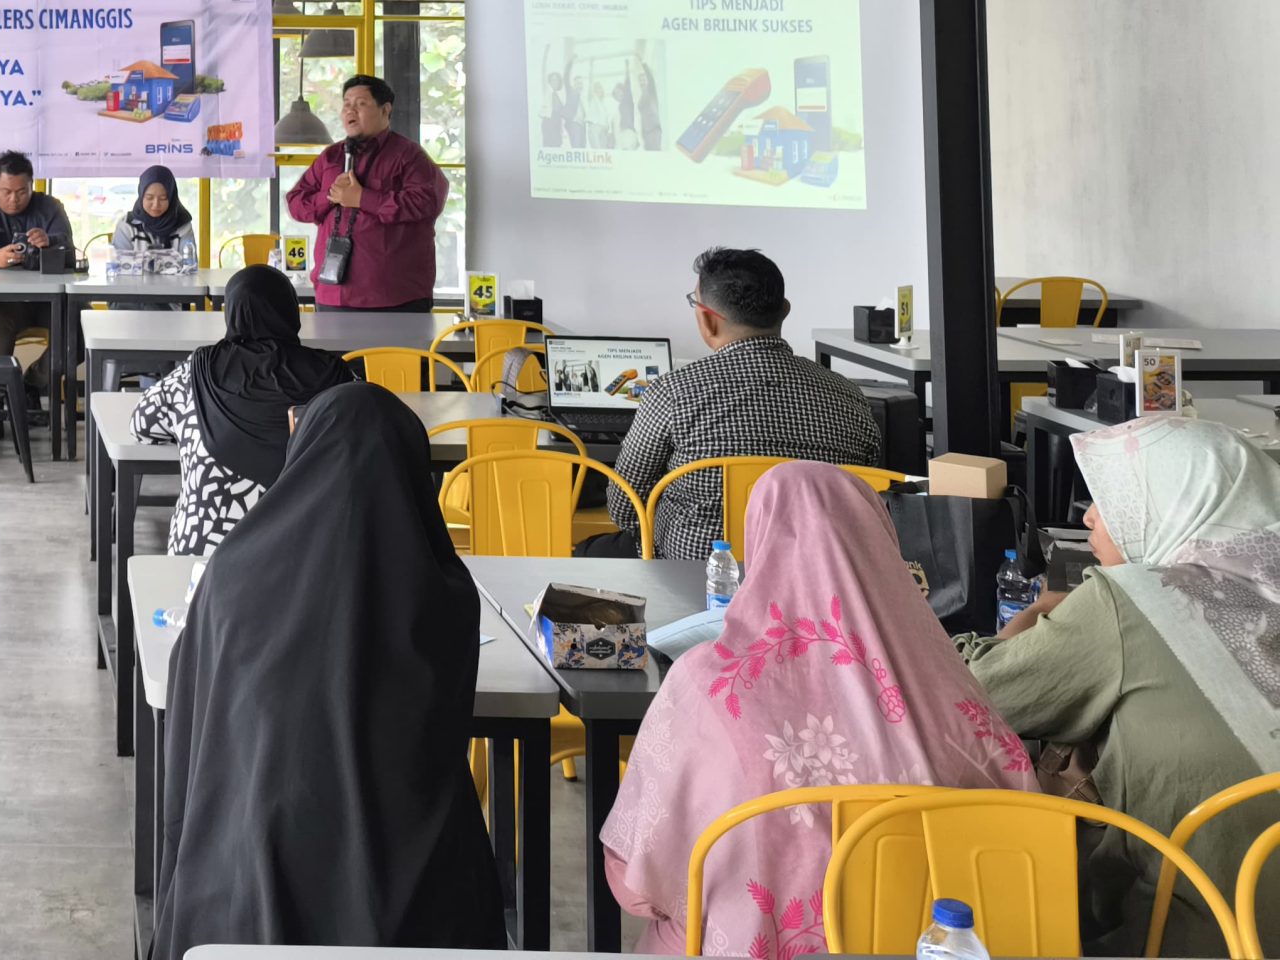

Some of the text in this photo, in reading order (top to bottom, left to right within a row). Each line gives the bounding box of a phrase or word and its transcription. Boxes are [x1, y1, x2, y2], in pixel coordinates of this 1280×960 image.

[39, 7, 133, 29] CIMANGGIS
[662, 17, 813, 33] AGEN BRILINK SUKSES
[288, 247, 304, 258] 46
[473, 285, 493, 298] 45
[1143, 358, 1156, 366] 50
